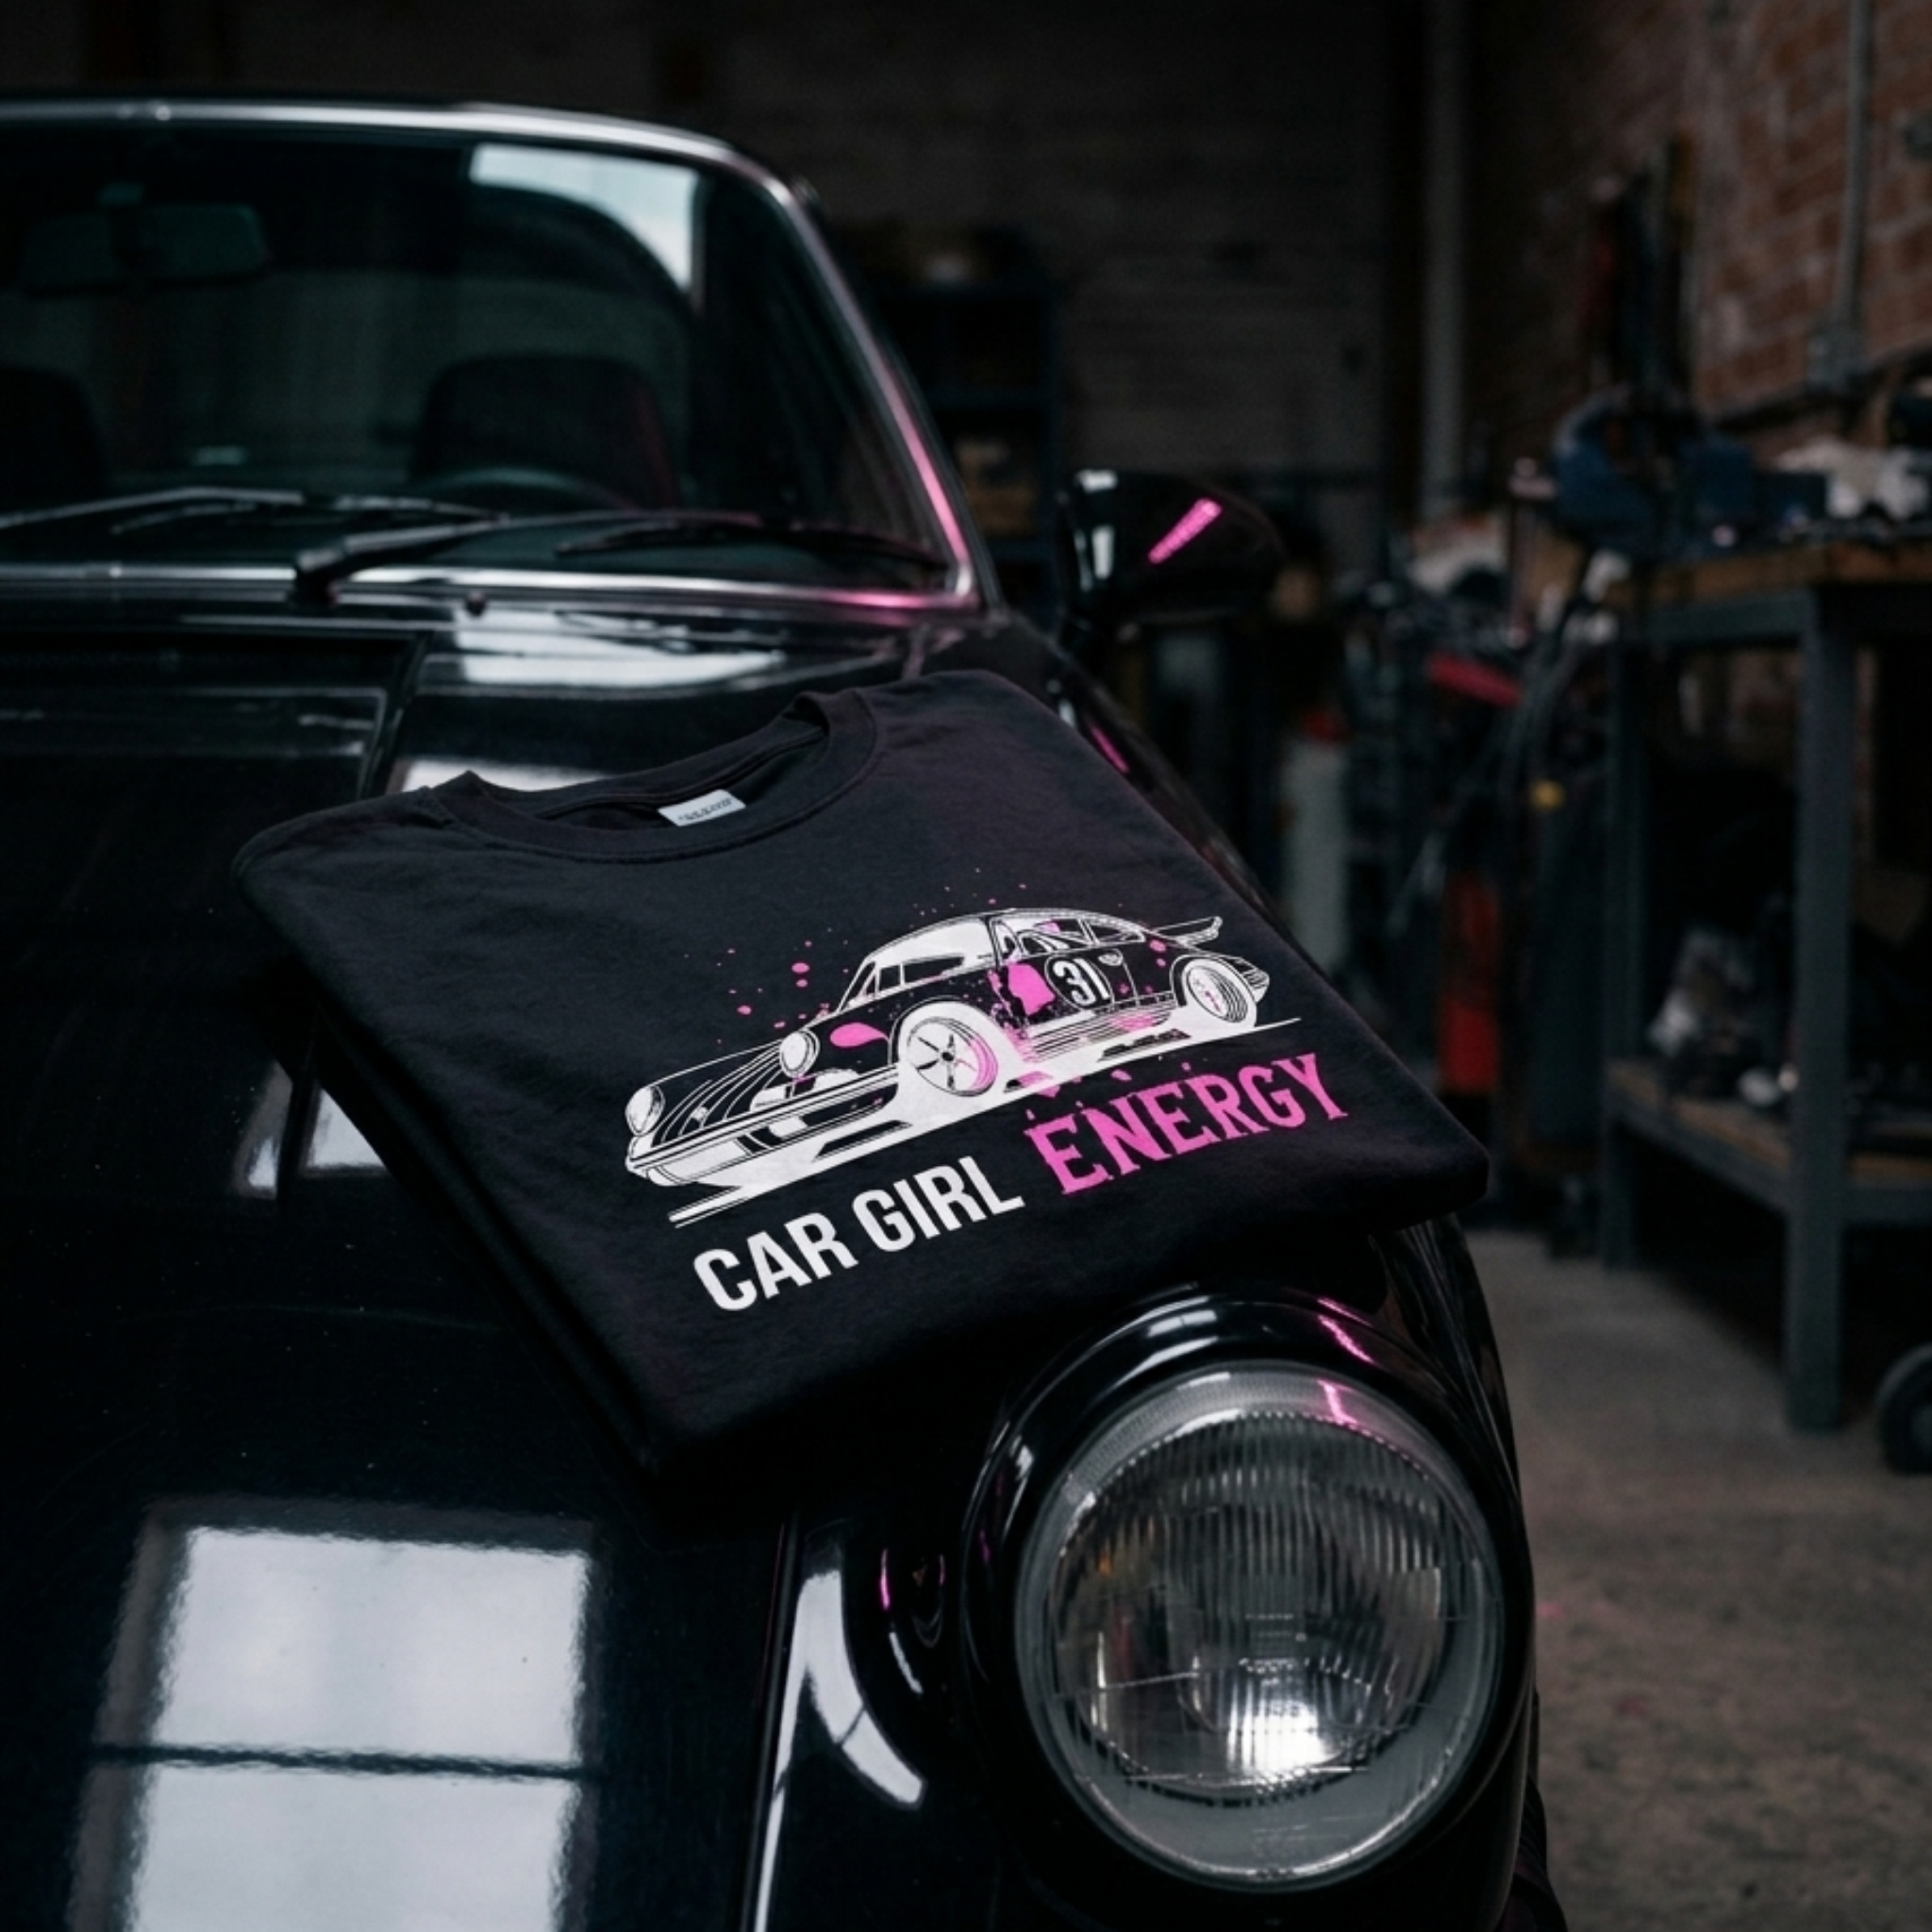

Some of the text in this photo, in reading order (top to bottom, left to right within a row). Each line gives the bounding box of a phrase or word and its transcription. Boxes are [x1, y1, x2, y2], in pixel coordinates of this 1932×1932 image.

[1052, 958, 1110, 1007] 31
[692, 1052, 1349, 1311] CAR GIRL ENERGY
